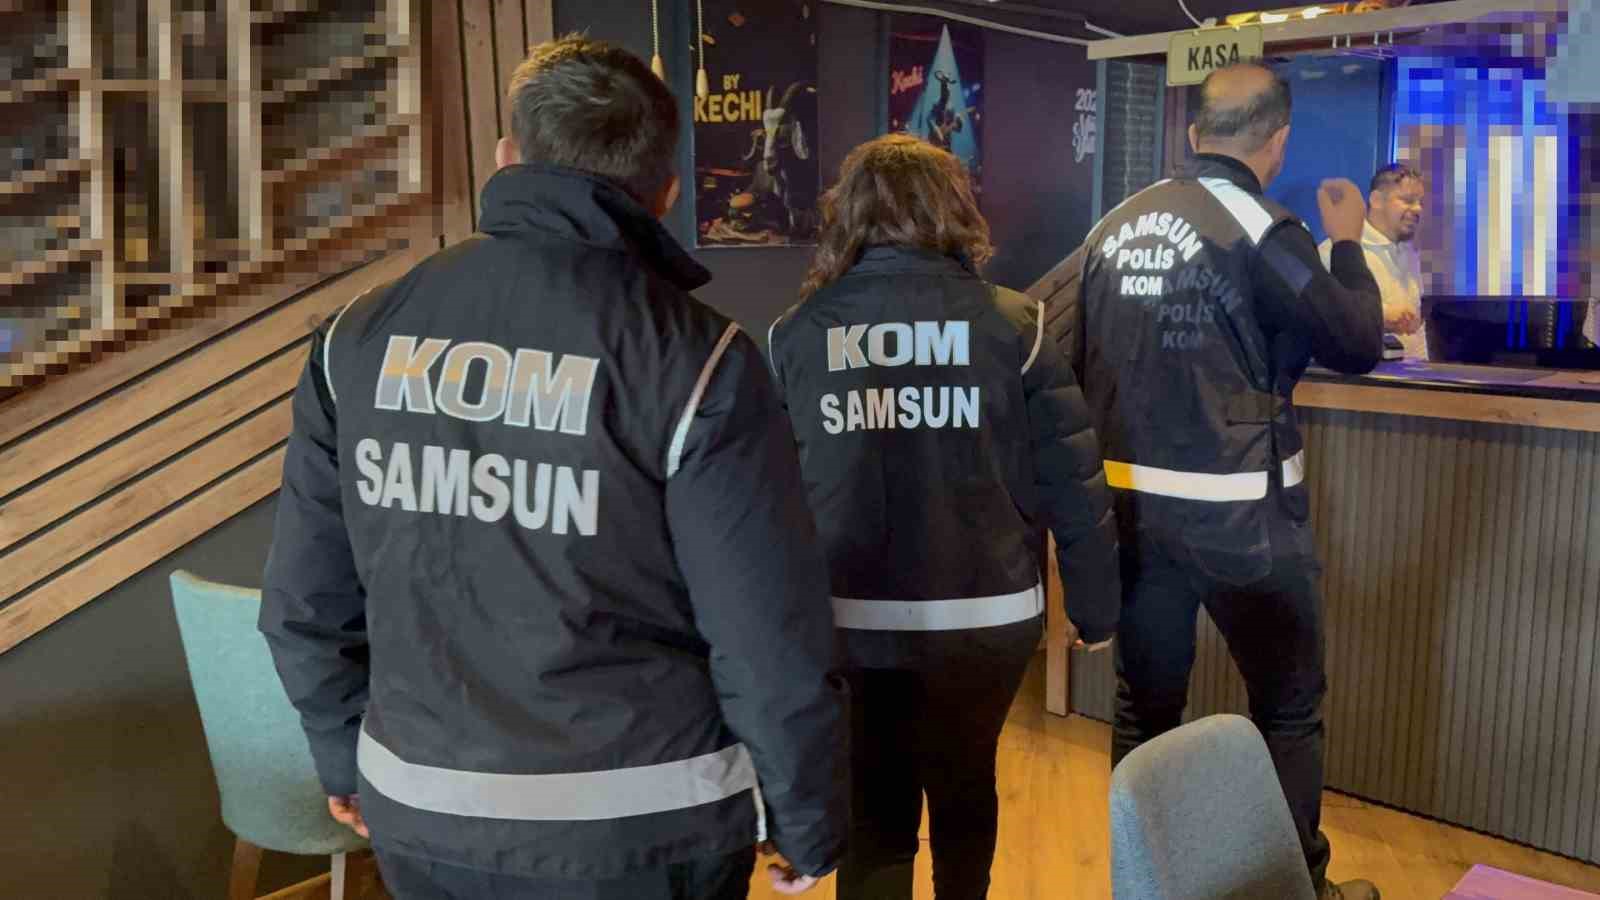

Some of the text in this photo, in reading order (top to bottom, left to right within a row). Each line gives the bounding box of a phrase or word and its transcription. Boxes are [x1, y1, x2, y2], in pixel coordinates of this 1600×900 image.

[1187, 43, 1240, 71] KASA
[723, 74, 740, 90] BY
[694, 90, 761, 122] KECHI
[1102, 211, 1203, 262] SAMSUN
[1116, 244, 1175, 270] POLİS
[1121, 275, 1164, 297] KOM
[827, 320, 971, 373] KOM
[374, 334, 600, 437] KOM
[820, 386, 980, 435] SAMSUN
[354, 437, 600, 536] SAMSUN
